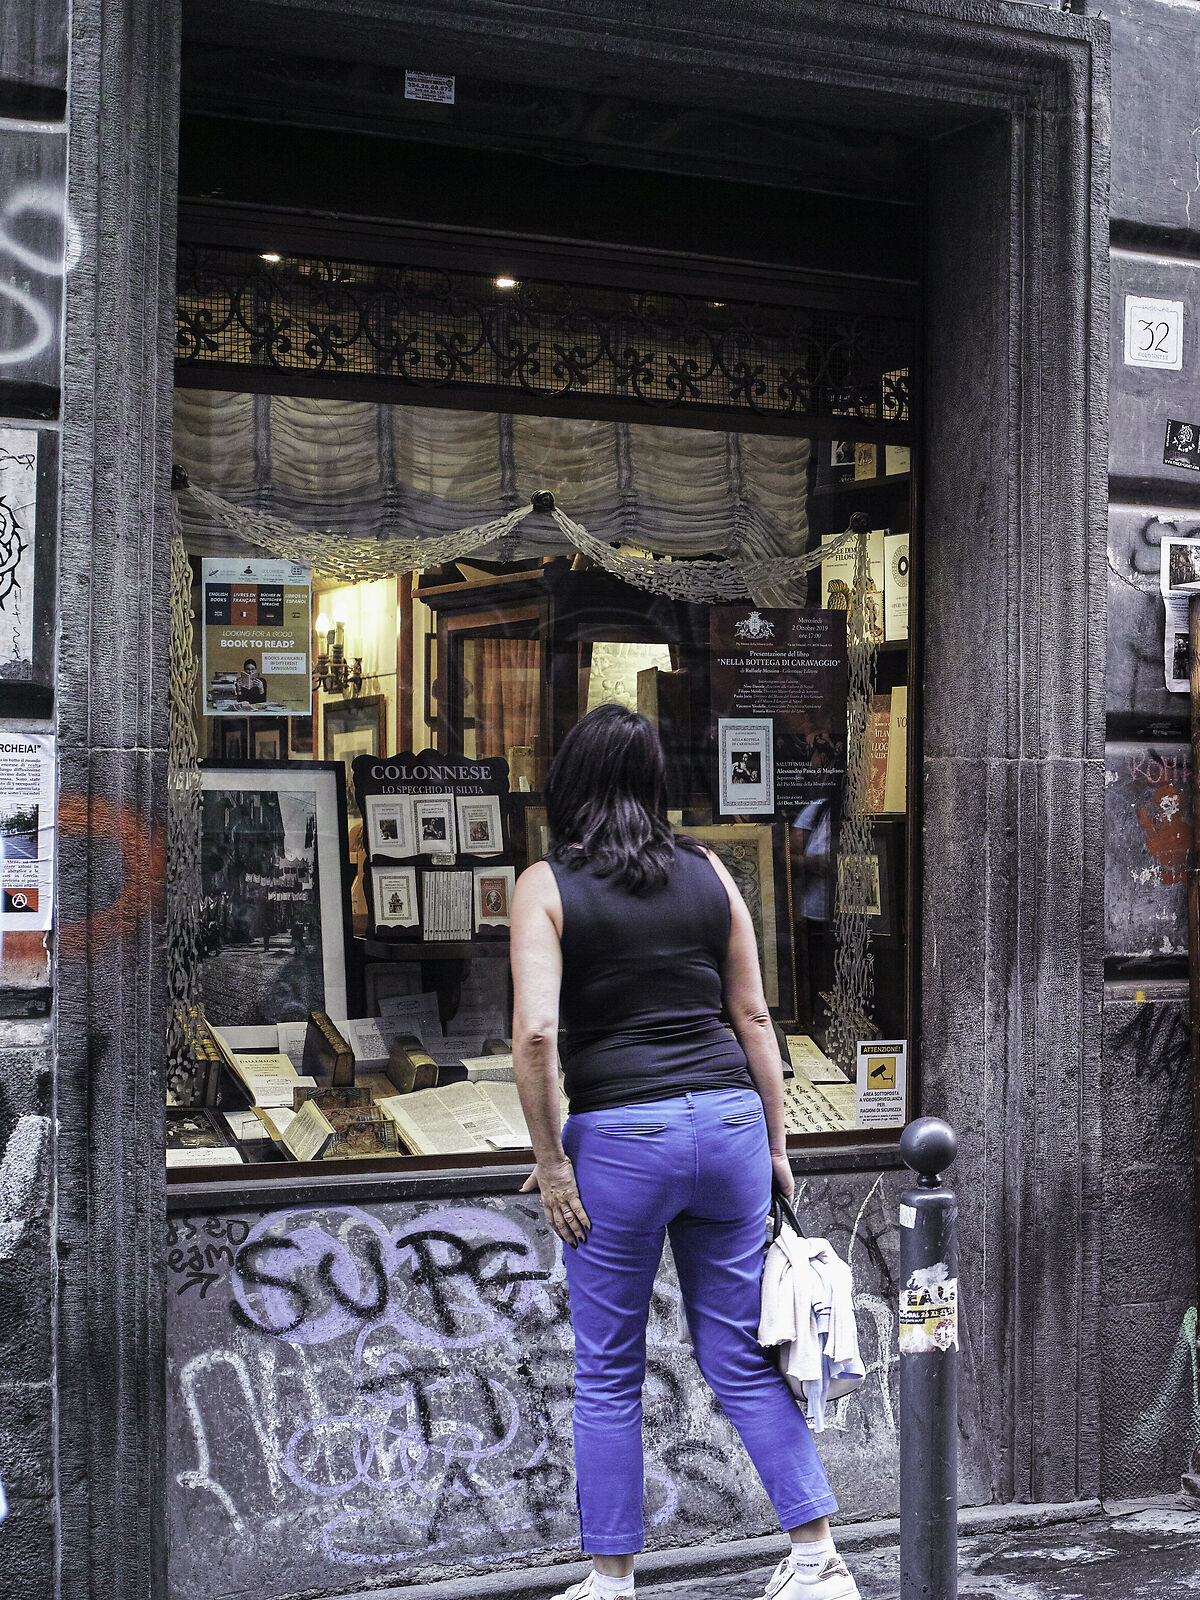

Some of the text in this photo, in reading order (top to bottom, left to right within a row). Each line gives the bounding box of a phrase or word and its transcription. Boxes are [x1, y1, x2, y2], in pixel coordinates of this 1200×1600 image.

[1137, 319, 1170, 354] 32
[220, 640, 295, 648] BOOK TO READ?
[370, 765, 493, 781] COLONNESE
[382, 785, 484, 794] LO SPECCHIO DI SILVIA
[863, 1045, 901, 1053] ATTENZIONE!
